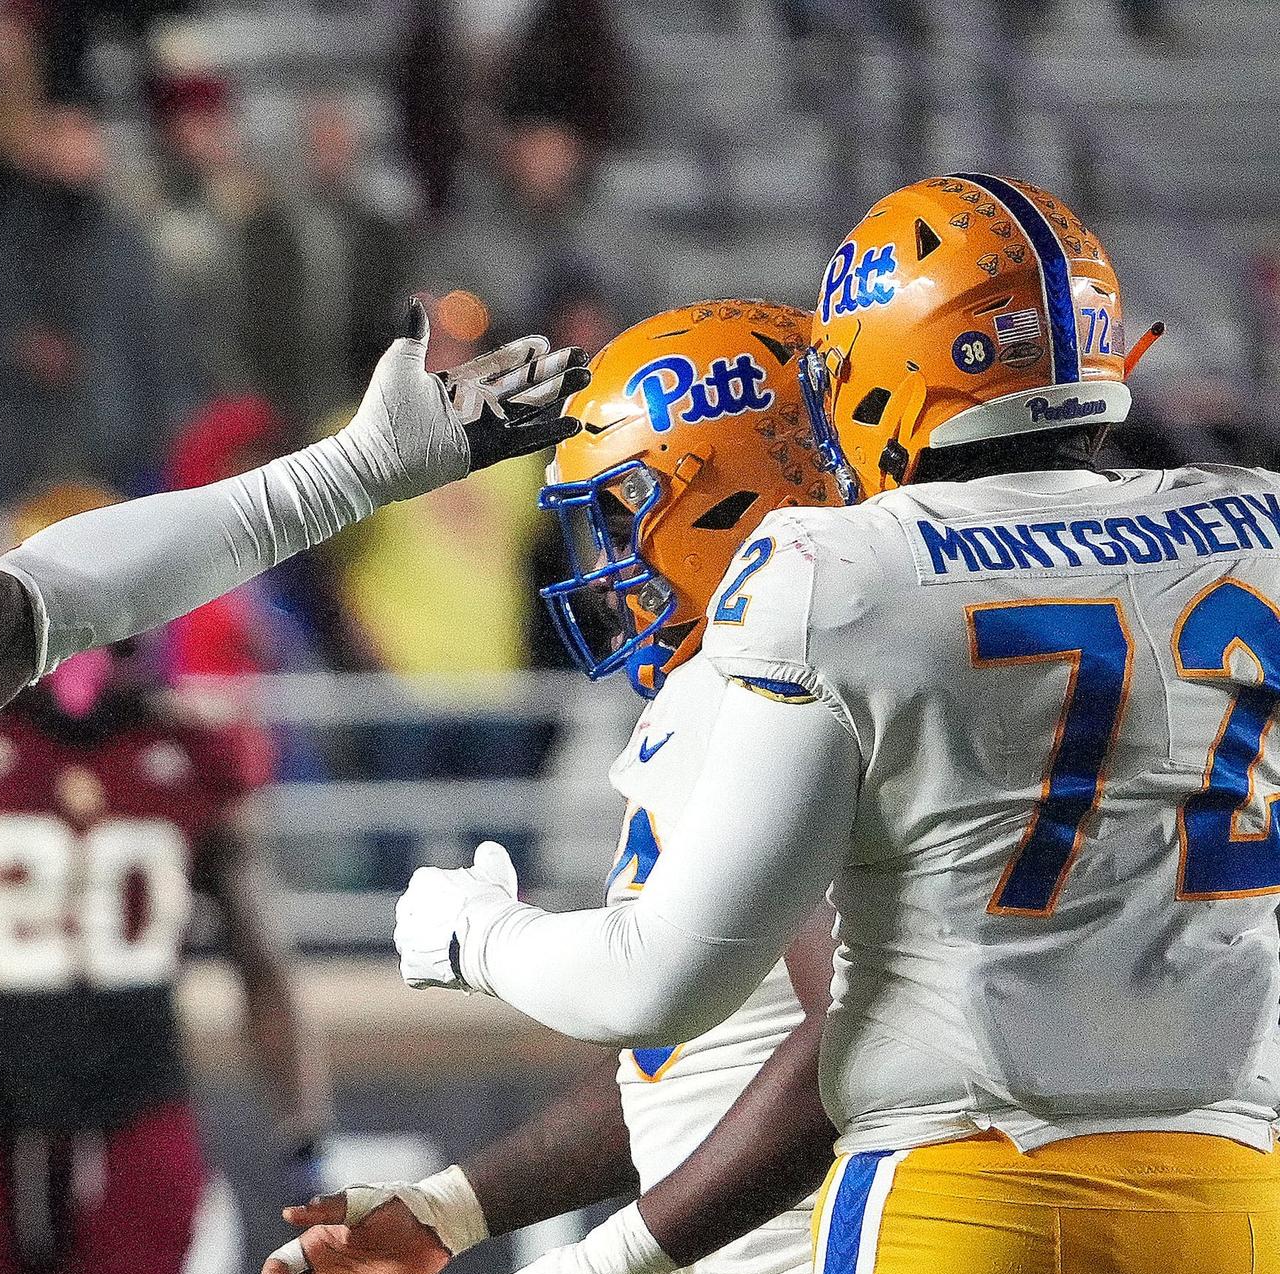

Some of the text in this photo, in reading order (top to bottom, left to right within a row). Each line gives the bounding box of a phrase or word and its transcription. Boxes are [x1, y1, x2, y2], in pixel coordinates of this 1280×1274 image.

[821, 240, 899, 325] Pitt
[960, 340, 986, 365] 38
[1081, 307, 1112, 355] 72
[625, 353, 776, 434] Pitt
[917, 492, 1280, 574] MONTGOMERY
[713, 535, 777, 626] 2
[964, 577, 1280, 917] 72
